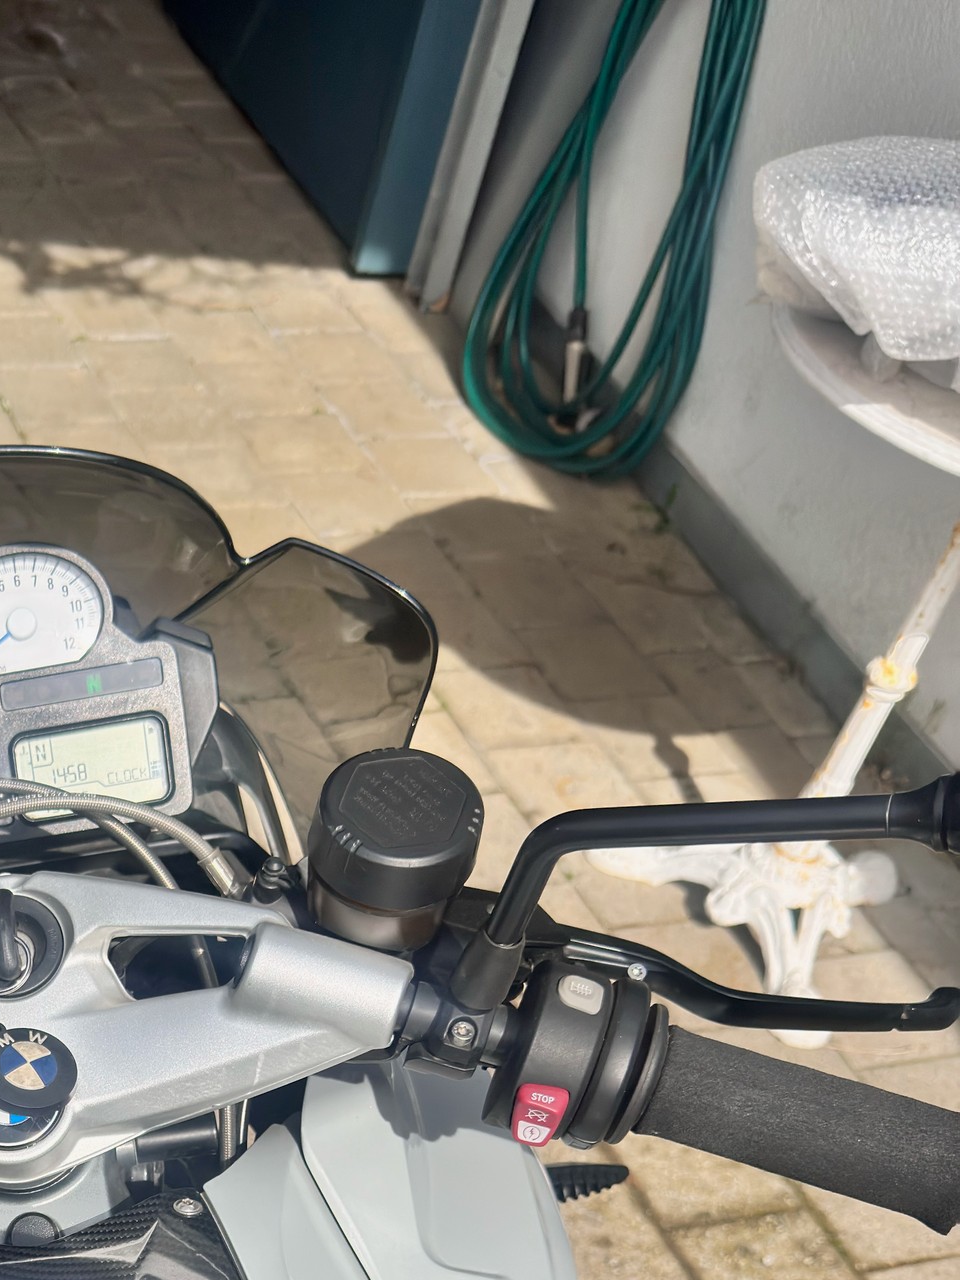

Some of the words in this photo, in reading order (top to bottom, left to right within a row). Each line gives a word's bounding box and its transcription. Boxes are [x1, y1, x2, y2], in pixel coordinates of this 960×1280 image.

[13, 575, 21, 587] 6
[31, 575, 37, 587] 7
[47, 578, 54, 590] 8
[62, 585, 69, 597] 9
[70, 600, 82, 613] 10
[75, 617, 84, 630] 11
[63, 637, 75, 650] 12
[86, 672, 103, 695] N
[34, 743, 47, 762] N
[52, 763, 88, 785] 1458
[107, 767, 148, 784] CLOCK
[531, 1092, 555, 1104] STOP
